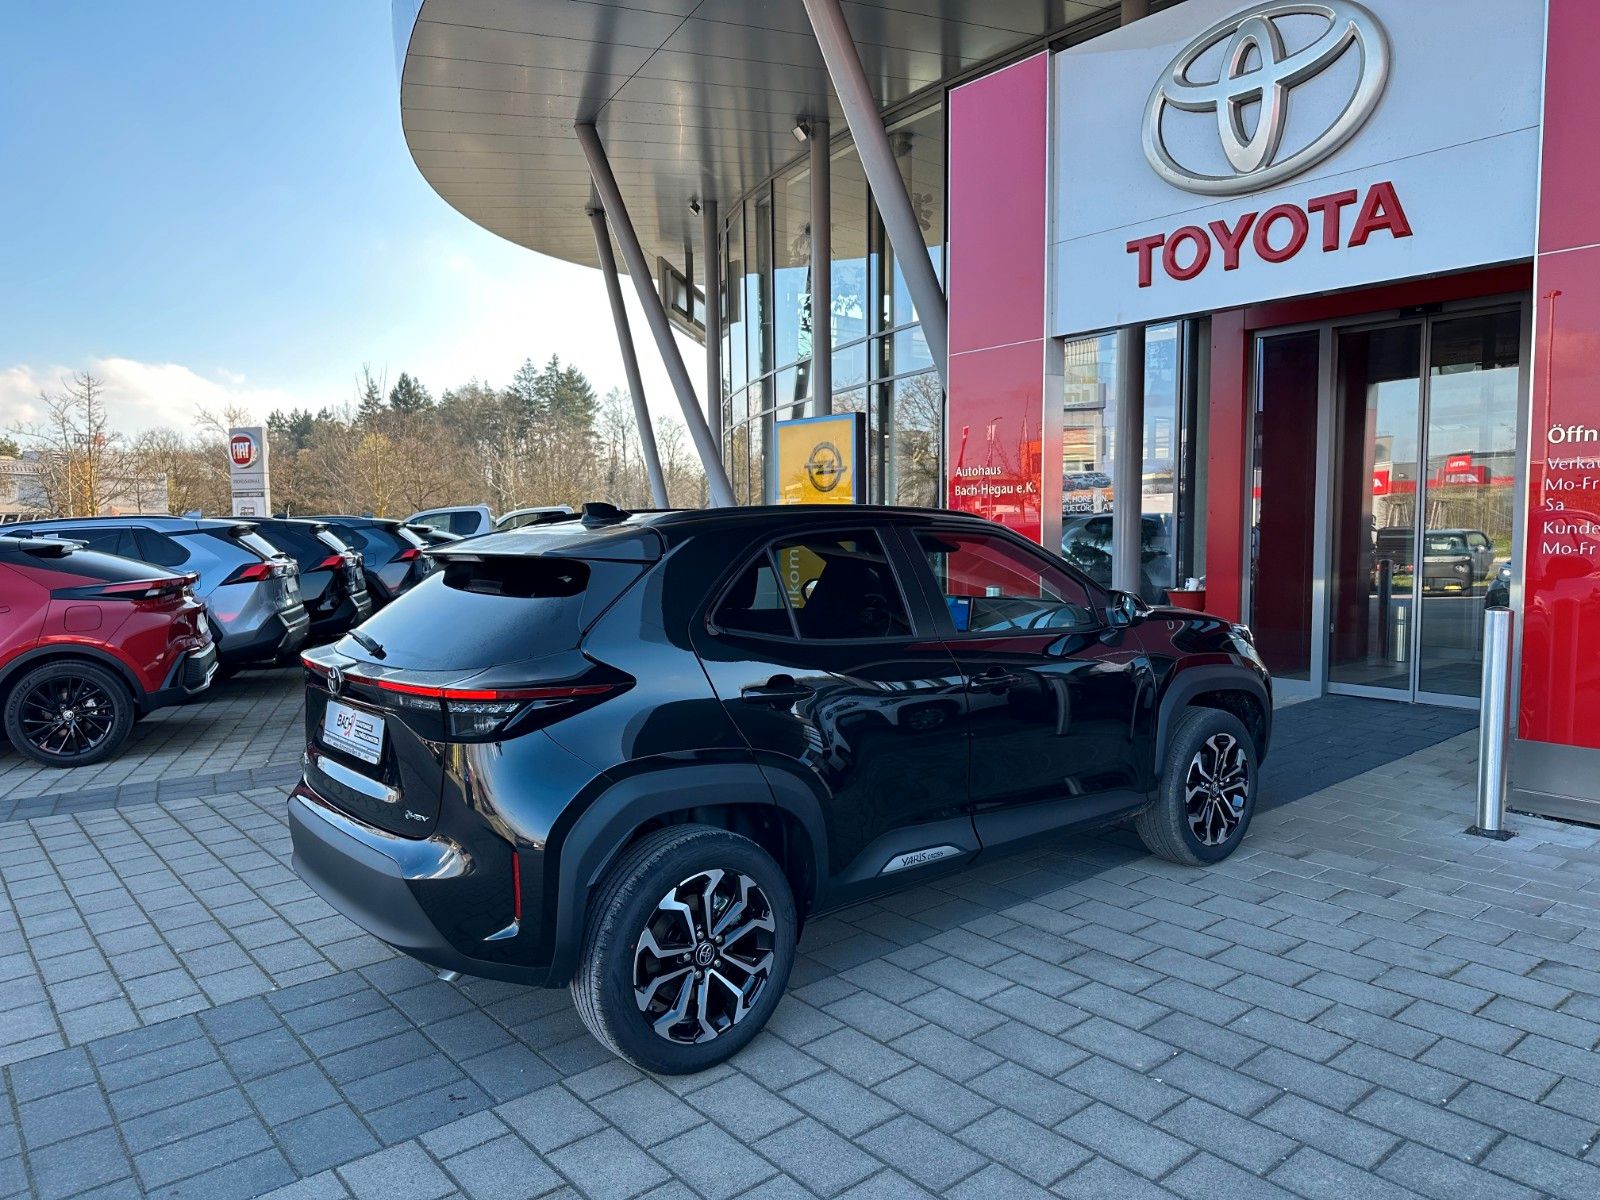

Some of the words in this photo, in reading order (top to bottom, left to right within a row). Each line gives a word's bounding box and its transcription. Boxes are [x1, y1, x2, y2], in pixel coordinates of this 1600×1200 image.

[1126, 181, 1413, 288] TOYOTA
[1547, 423, 1598, 444] Öffn
[232, 441, 250, 460] FIAT
[955, 464, 1002, 477] Autohaus
[955, 483, 1013, 498] Bach-Hegau
[1016, 481, 1036, 494] e.K.
[1545, 477, 1600, 490] Mo-Fr
[1545, 498, 1565, 511] Sa
[1542, 541, 1597, 555] Mo-Fr
[337, 713, 352, 730] BACH
[901, 852, 927, 867] YARIS
